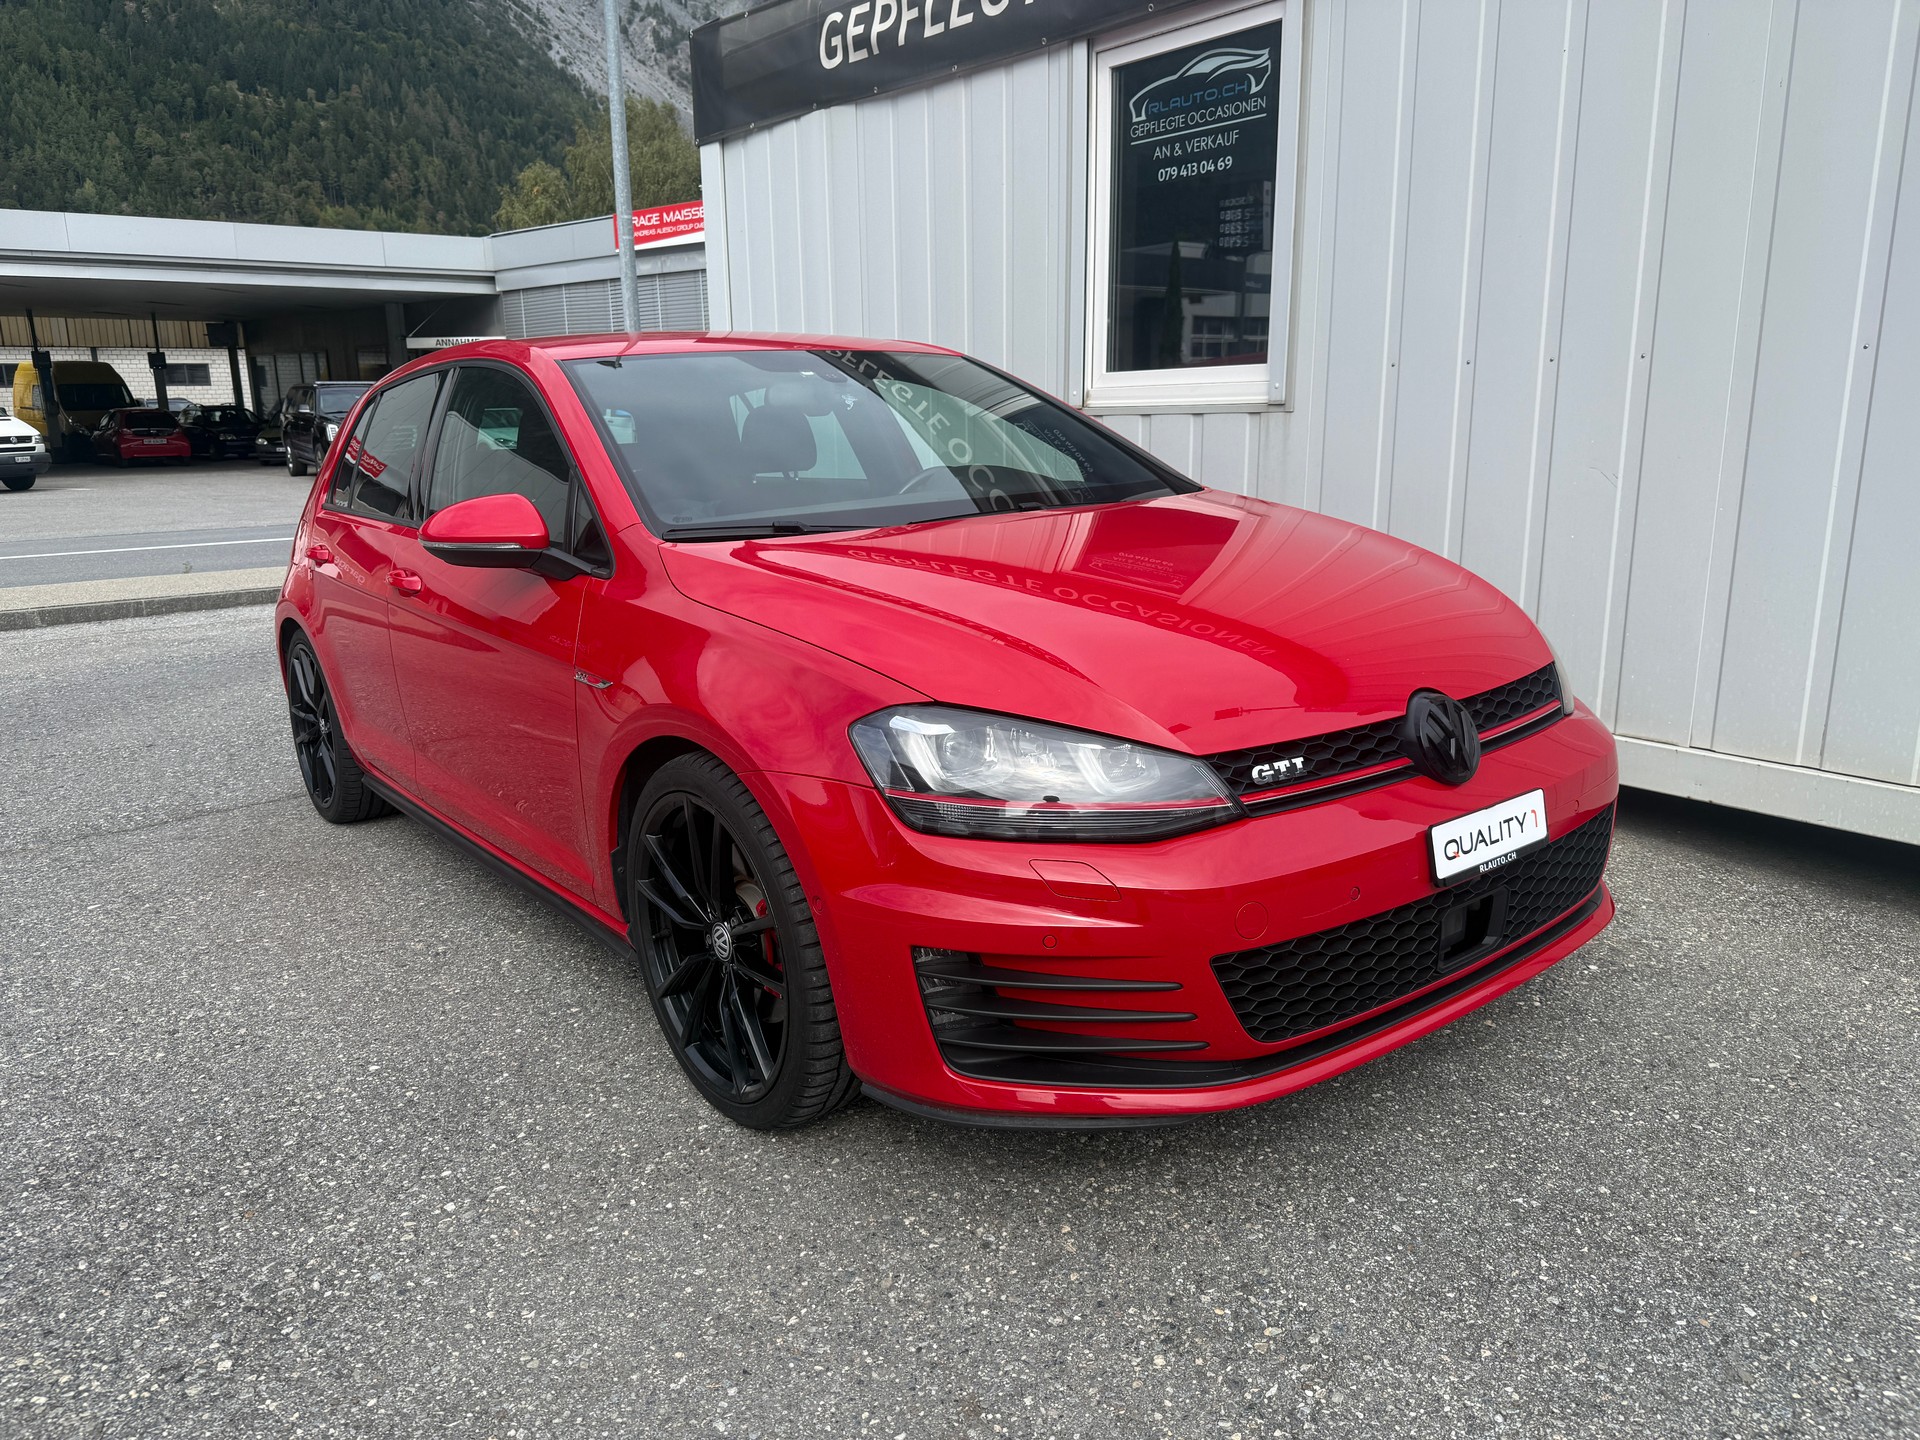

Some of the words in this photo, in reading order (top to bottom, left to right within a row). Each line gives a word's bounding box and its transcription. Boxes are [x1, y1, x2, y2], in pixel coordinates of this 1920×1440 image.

[1148, 81, 1248, 114] RLAUTO.CH
[1130, 114, 1186, 138] GEPFLEGTE
[1187, 96, 1267, 125] OCCASIONEN
[1153, 144, 1171, 160] AN
[1173, 142, 1182, 156] &
[1185, 129, 1239, 153] VERKAUF
[1157, 166, 1178, 182] 079
[1179, 162, 1197, 177] 413
[1199, 160, 1215, 174] 04
[1217, 156, 1233, 170] 69
[632, 213, 660, 227] RAGE
[663, 206, 704, 223] MAISSE
[1251, 756, 1307, 785] GTI
[1444, 812, 1527, 861] QUALITY
[1530, 809, 1538, 828] 1
[1479, 851, 1517, 873] RLAUTO.CH
